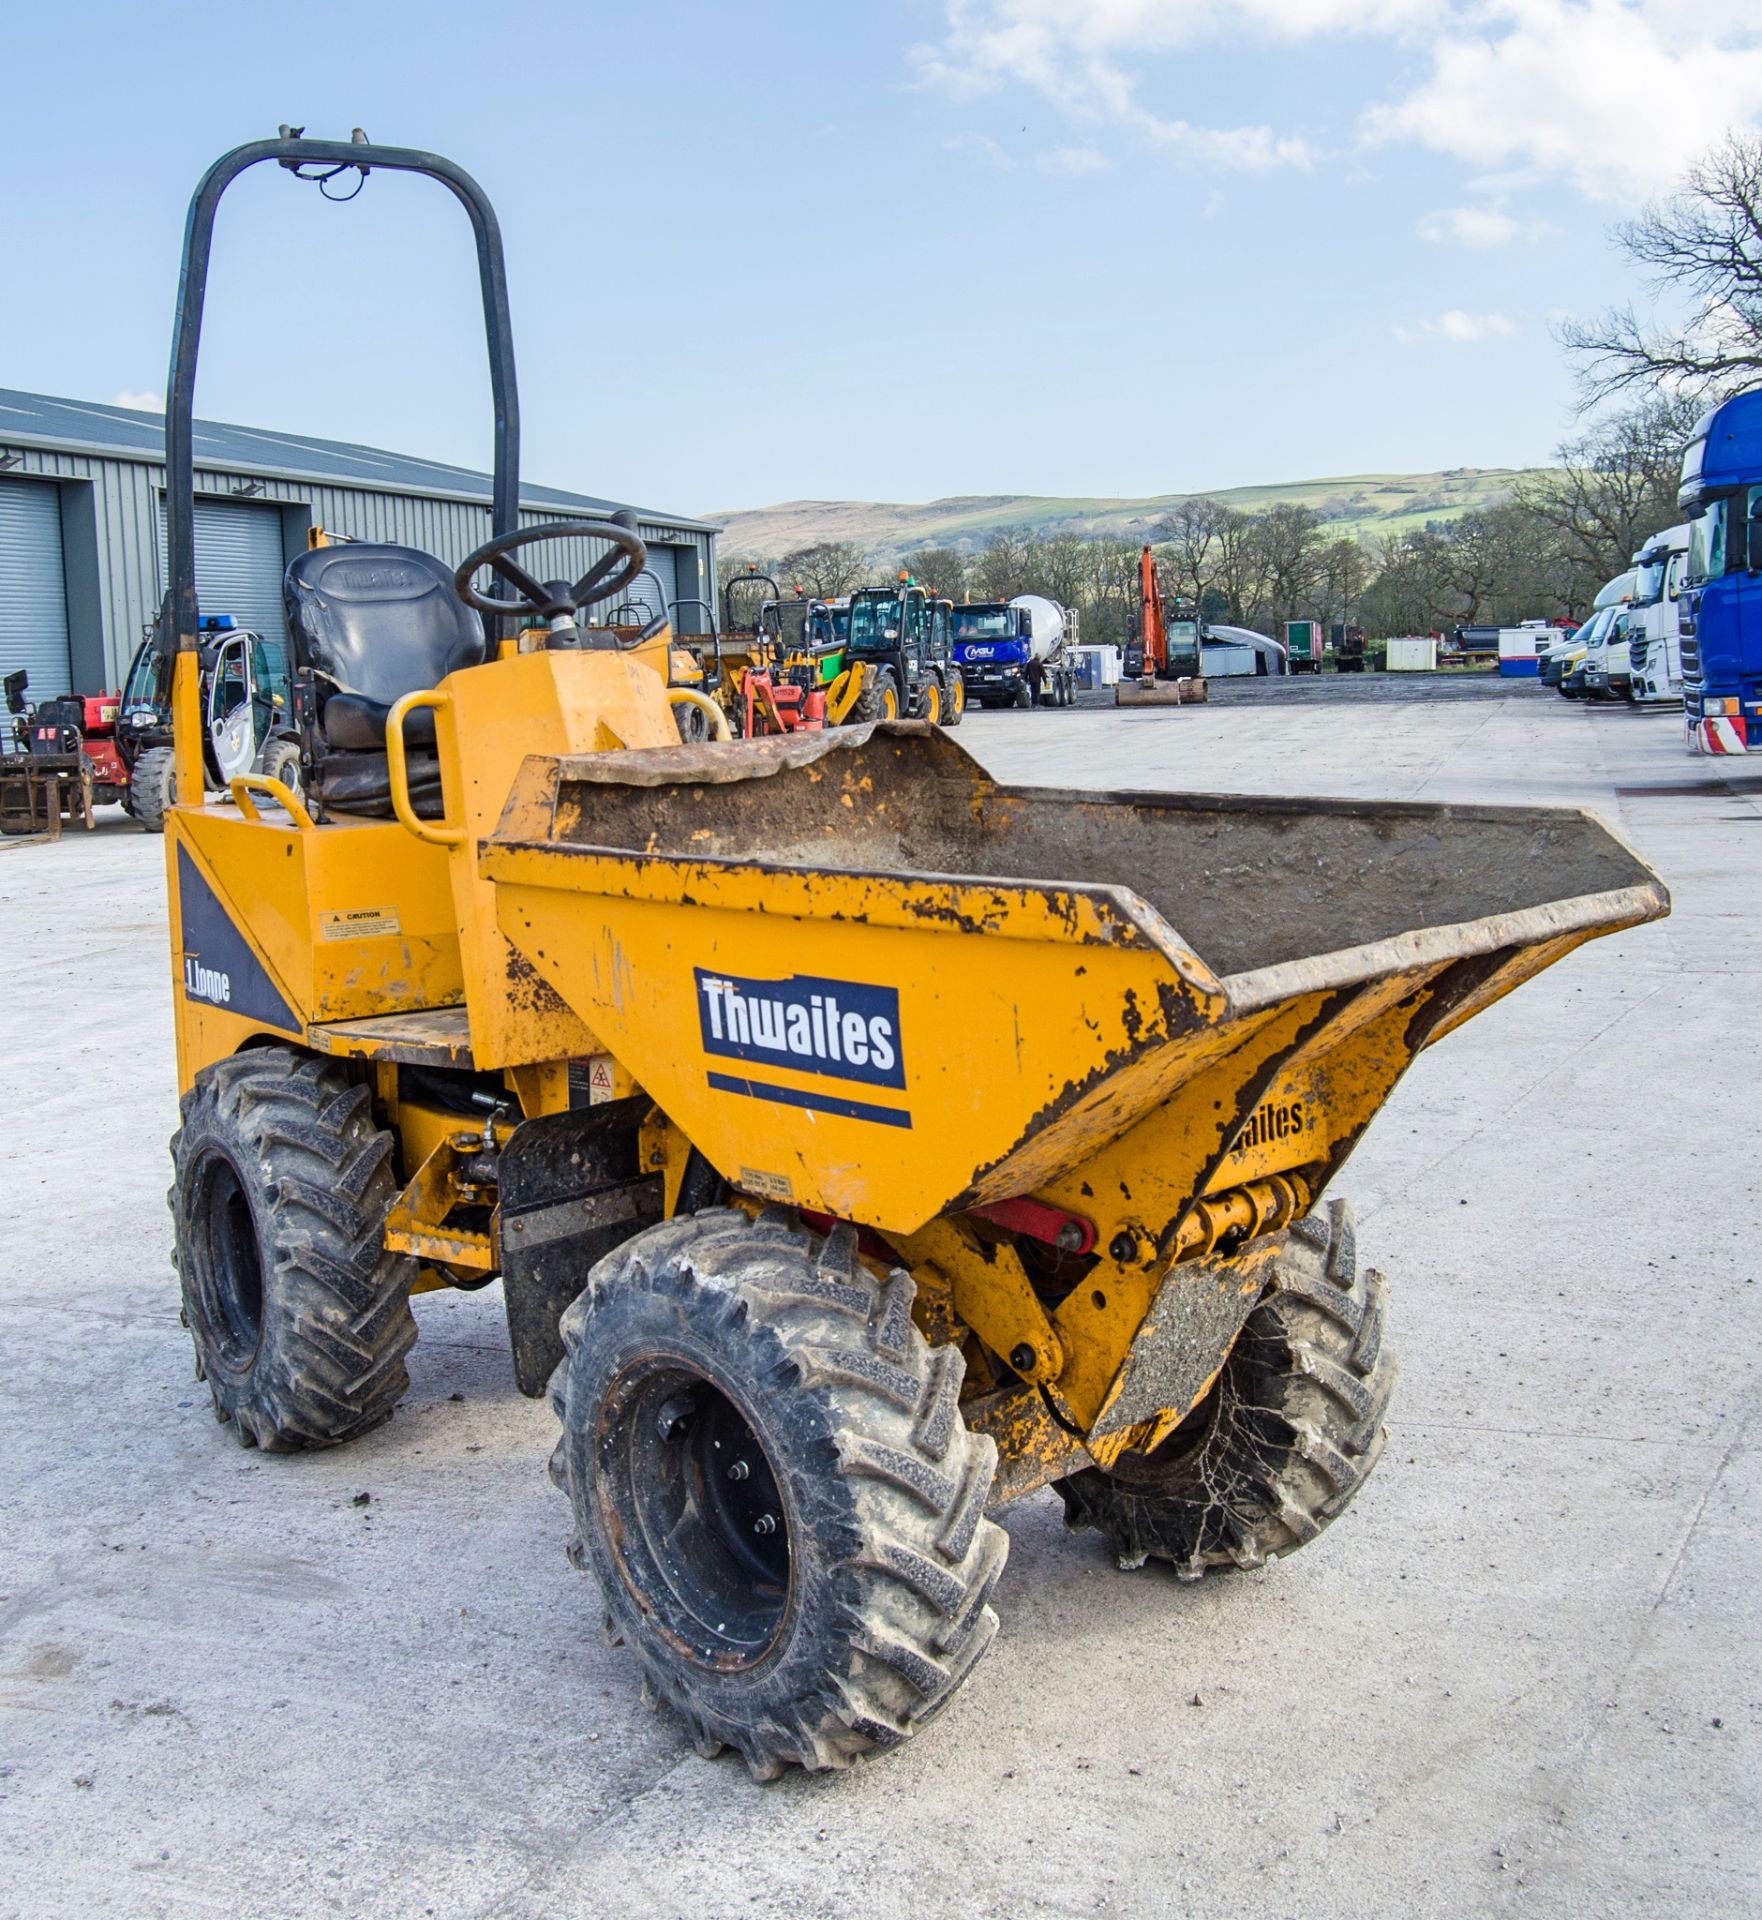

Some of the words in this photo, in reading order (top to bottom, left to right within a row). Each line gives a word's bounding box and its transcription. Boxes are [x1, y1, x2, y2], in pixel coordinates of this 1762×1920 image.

[346, 911, 381, 920] CAUTION
[194, 959, 230, 1002] tonne
[702, 977, 896, 1071] Thwaites
